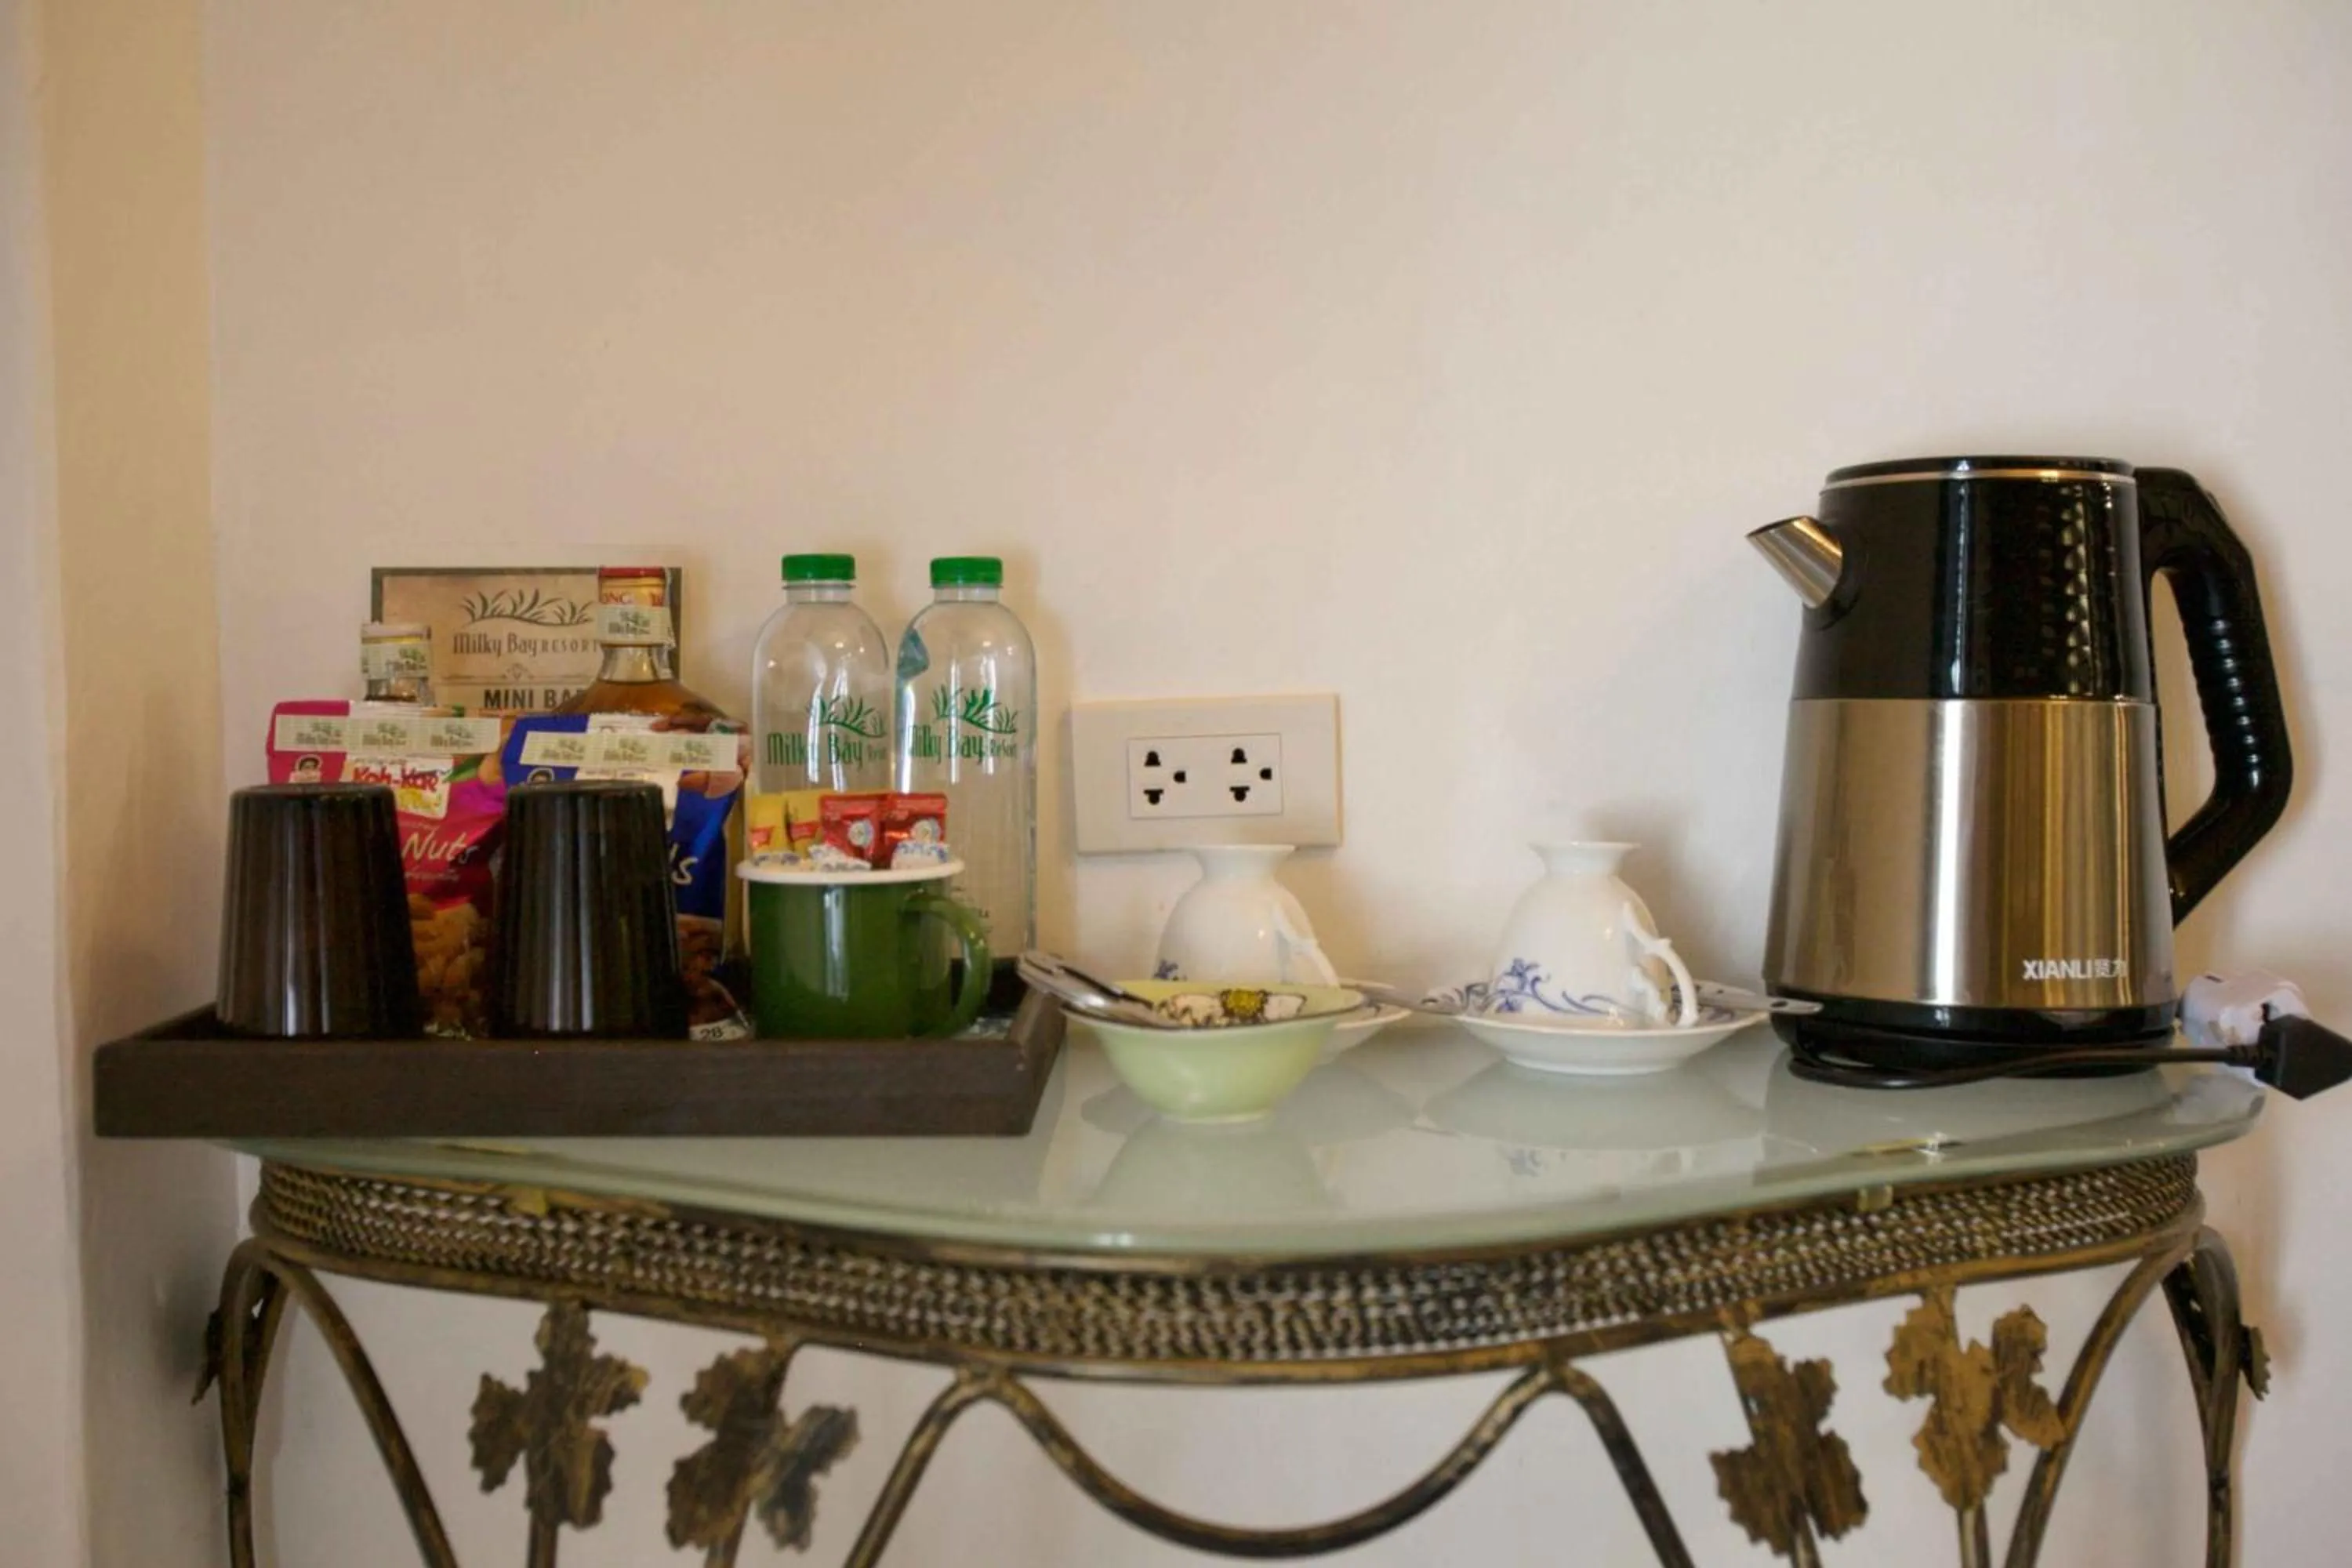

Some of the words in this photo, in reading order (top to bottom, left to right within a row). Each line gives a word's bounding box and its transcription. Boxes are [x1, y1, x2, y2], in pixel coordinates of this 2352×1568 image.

[453, 632, 502, 659] Milky
[506, 632, 538, 659] Bay
[484, 688, 534, 710] MINI
[543, 688, 583, 710] BA
[401, 829, 479, 864] Nuts
[2022, 959, 2092, 980] XIANLI
